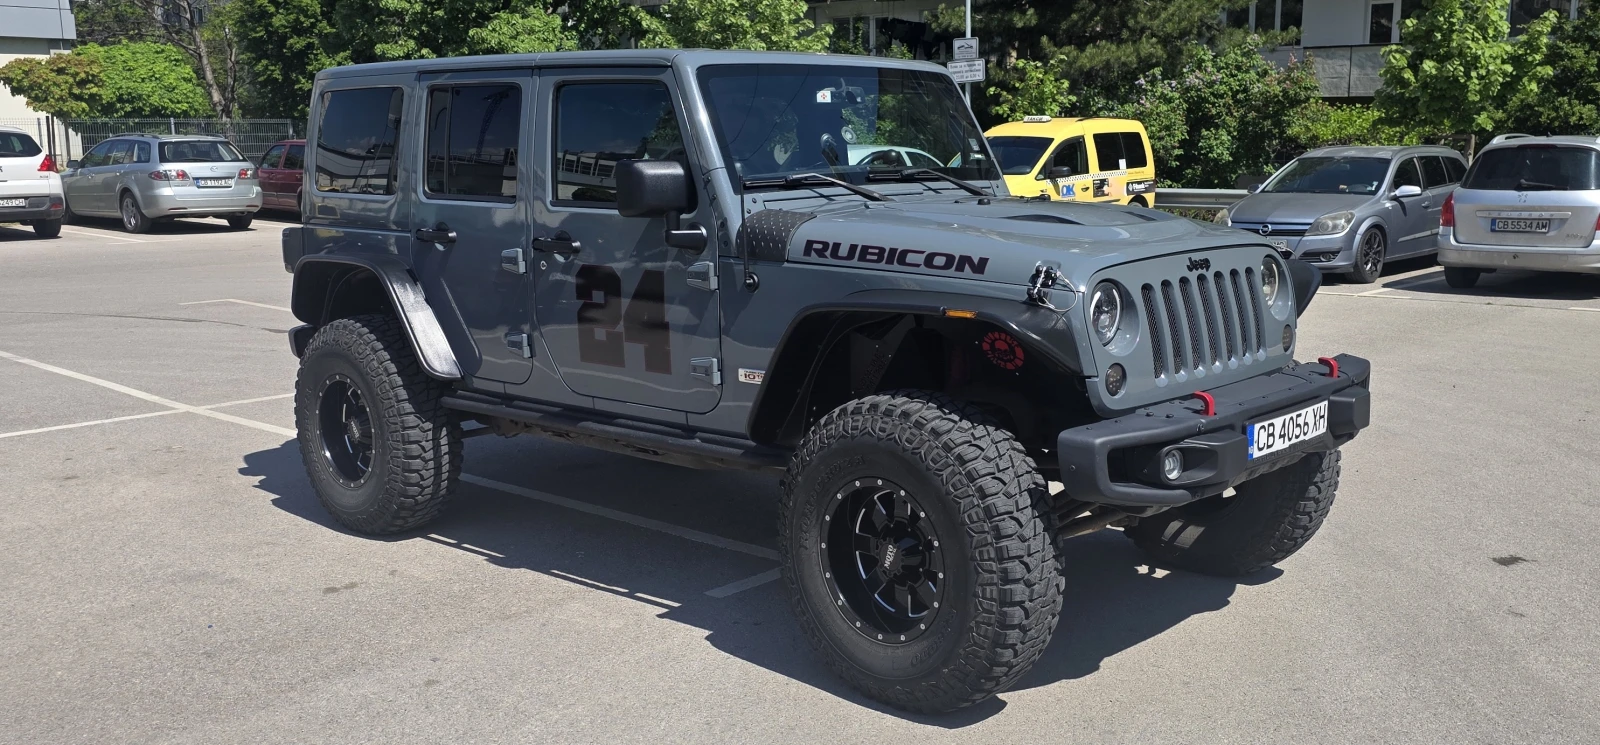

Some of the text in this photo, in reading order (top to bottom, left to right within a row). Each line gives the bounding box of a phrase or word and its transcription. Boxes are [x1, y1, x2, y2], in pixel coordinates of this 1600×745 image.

[1061, 184, 1075, 197] OK
[1497, 220, 1548, 231] CB 5534 AM
[803, 239, 990, 275] RUBICON
[1186, 256, 1211, 272] Jeep
[575, 264, 672, 375] 24
[1257, 422, 1275, 452] CB
[1278, 410, 1309, 445] 4056
[1311, 403, 1327, 435] XH
